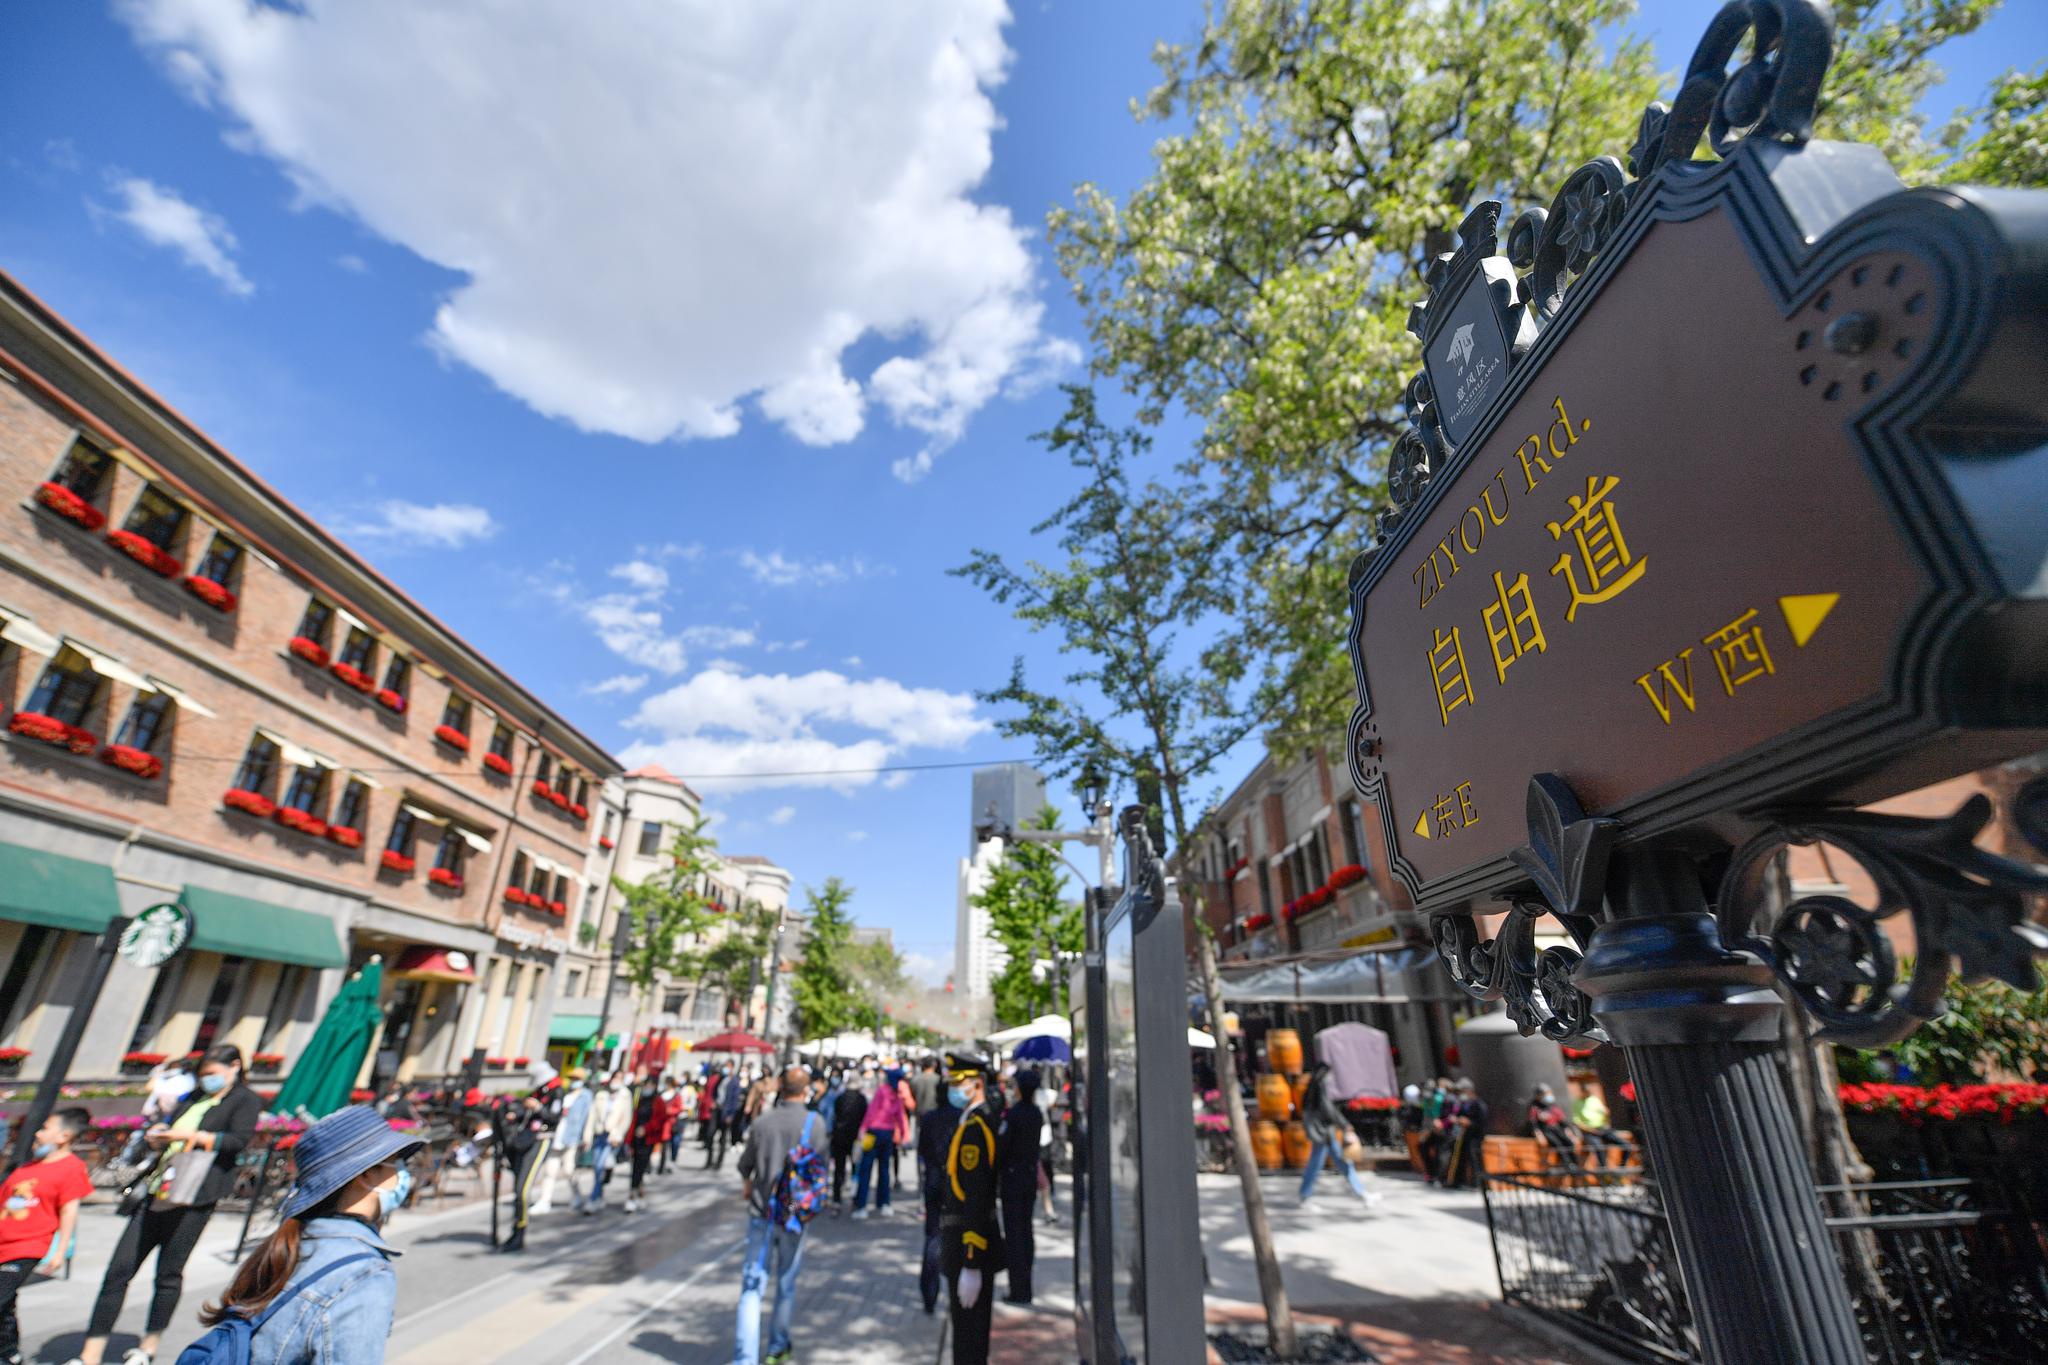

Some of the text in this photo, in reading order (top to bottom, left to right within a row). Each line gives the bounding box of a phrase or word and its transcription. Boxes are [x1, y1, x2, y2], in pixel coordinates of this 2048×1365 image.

[1412, 396, 1592, 609] ZIYOU Rd.
[1426, 475, 1648, 726] 自由道
[1634, 607, 1777, 726] W 西
